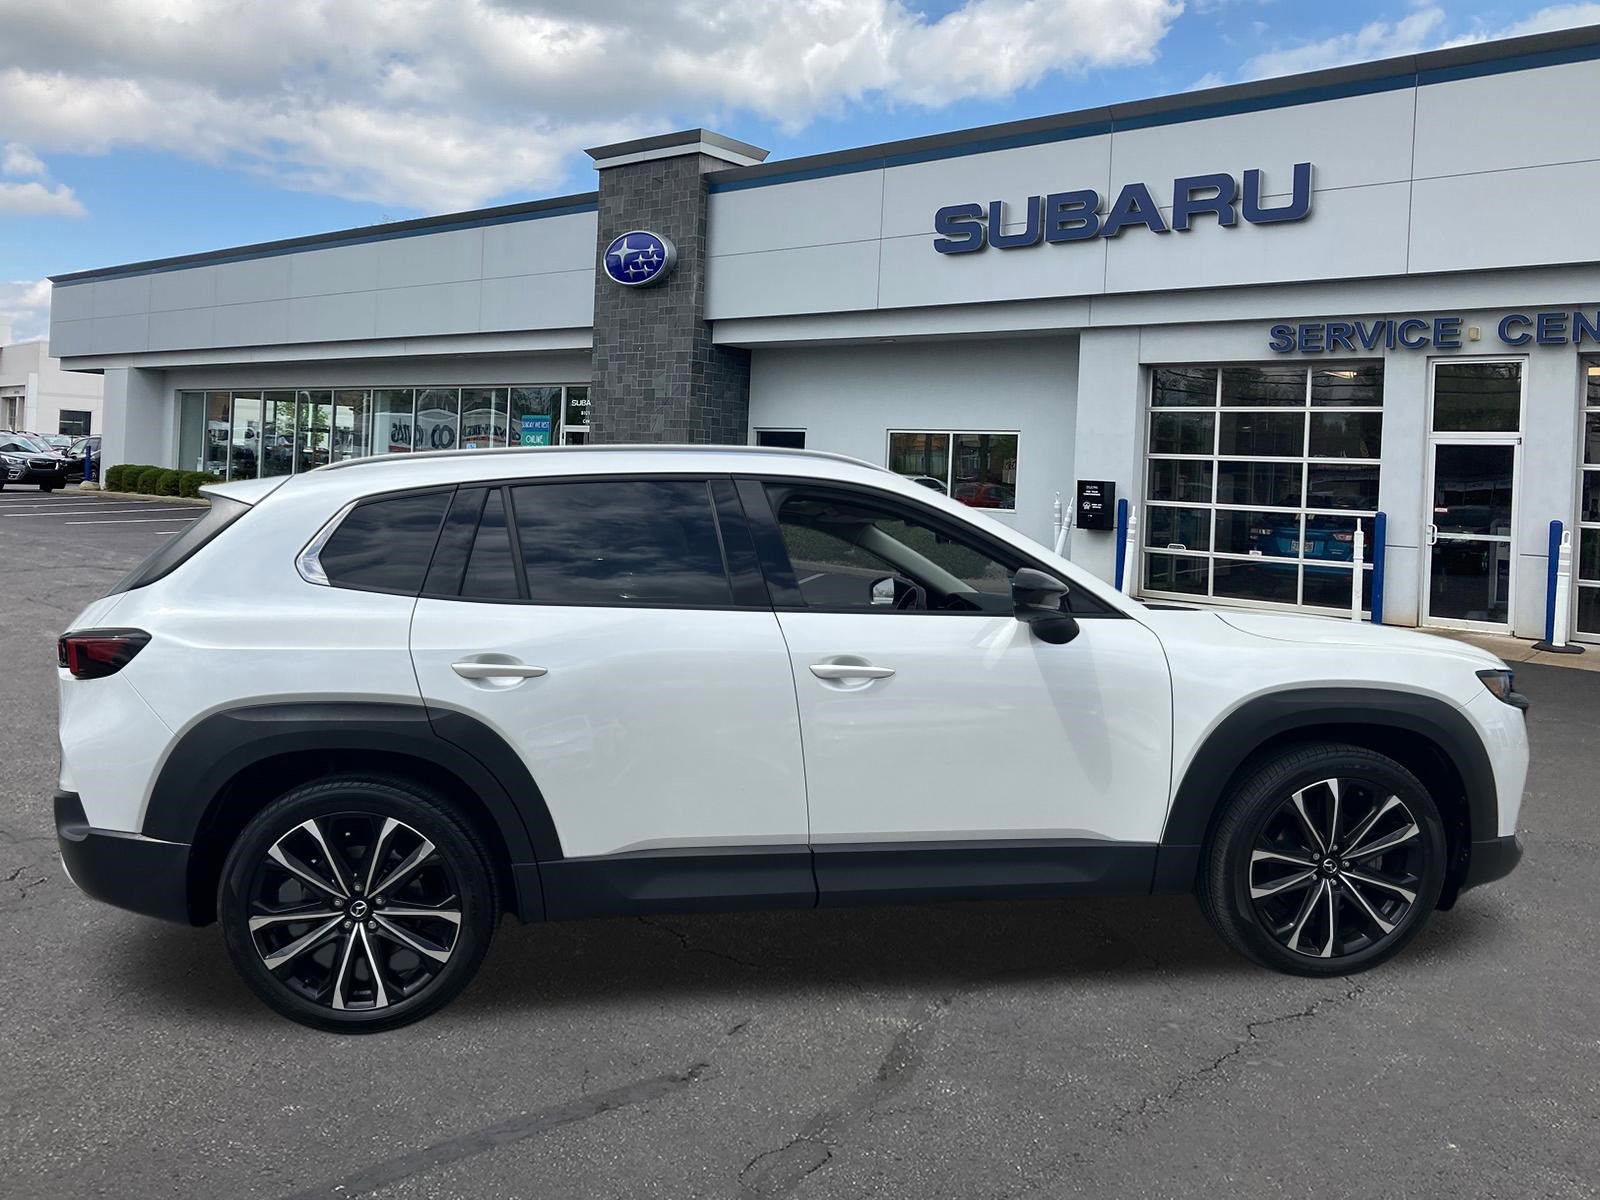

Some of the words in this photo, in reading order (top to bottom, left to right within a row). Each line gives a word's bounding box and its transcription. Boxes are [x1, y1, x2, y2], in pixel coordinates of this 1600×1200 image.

[933, 161, 1313, 254] SUBARU
[1269, 317, 1463, 353] SERVICE
[1497, 311, 1600, 346] CEN
